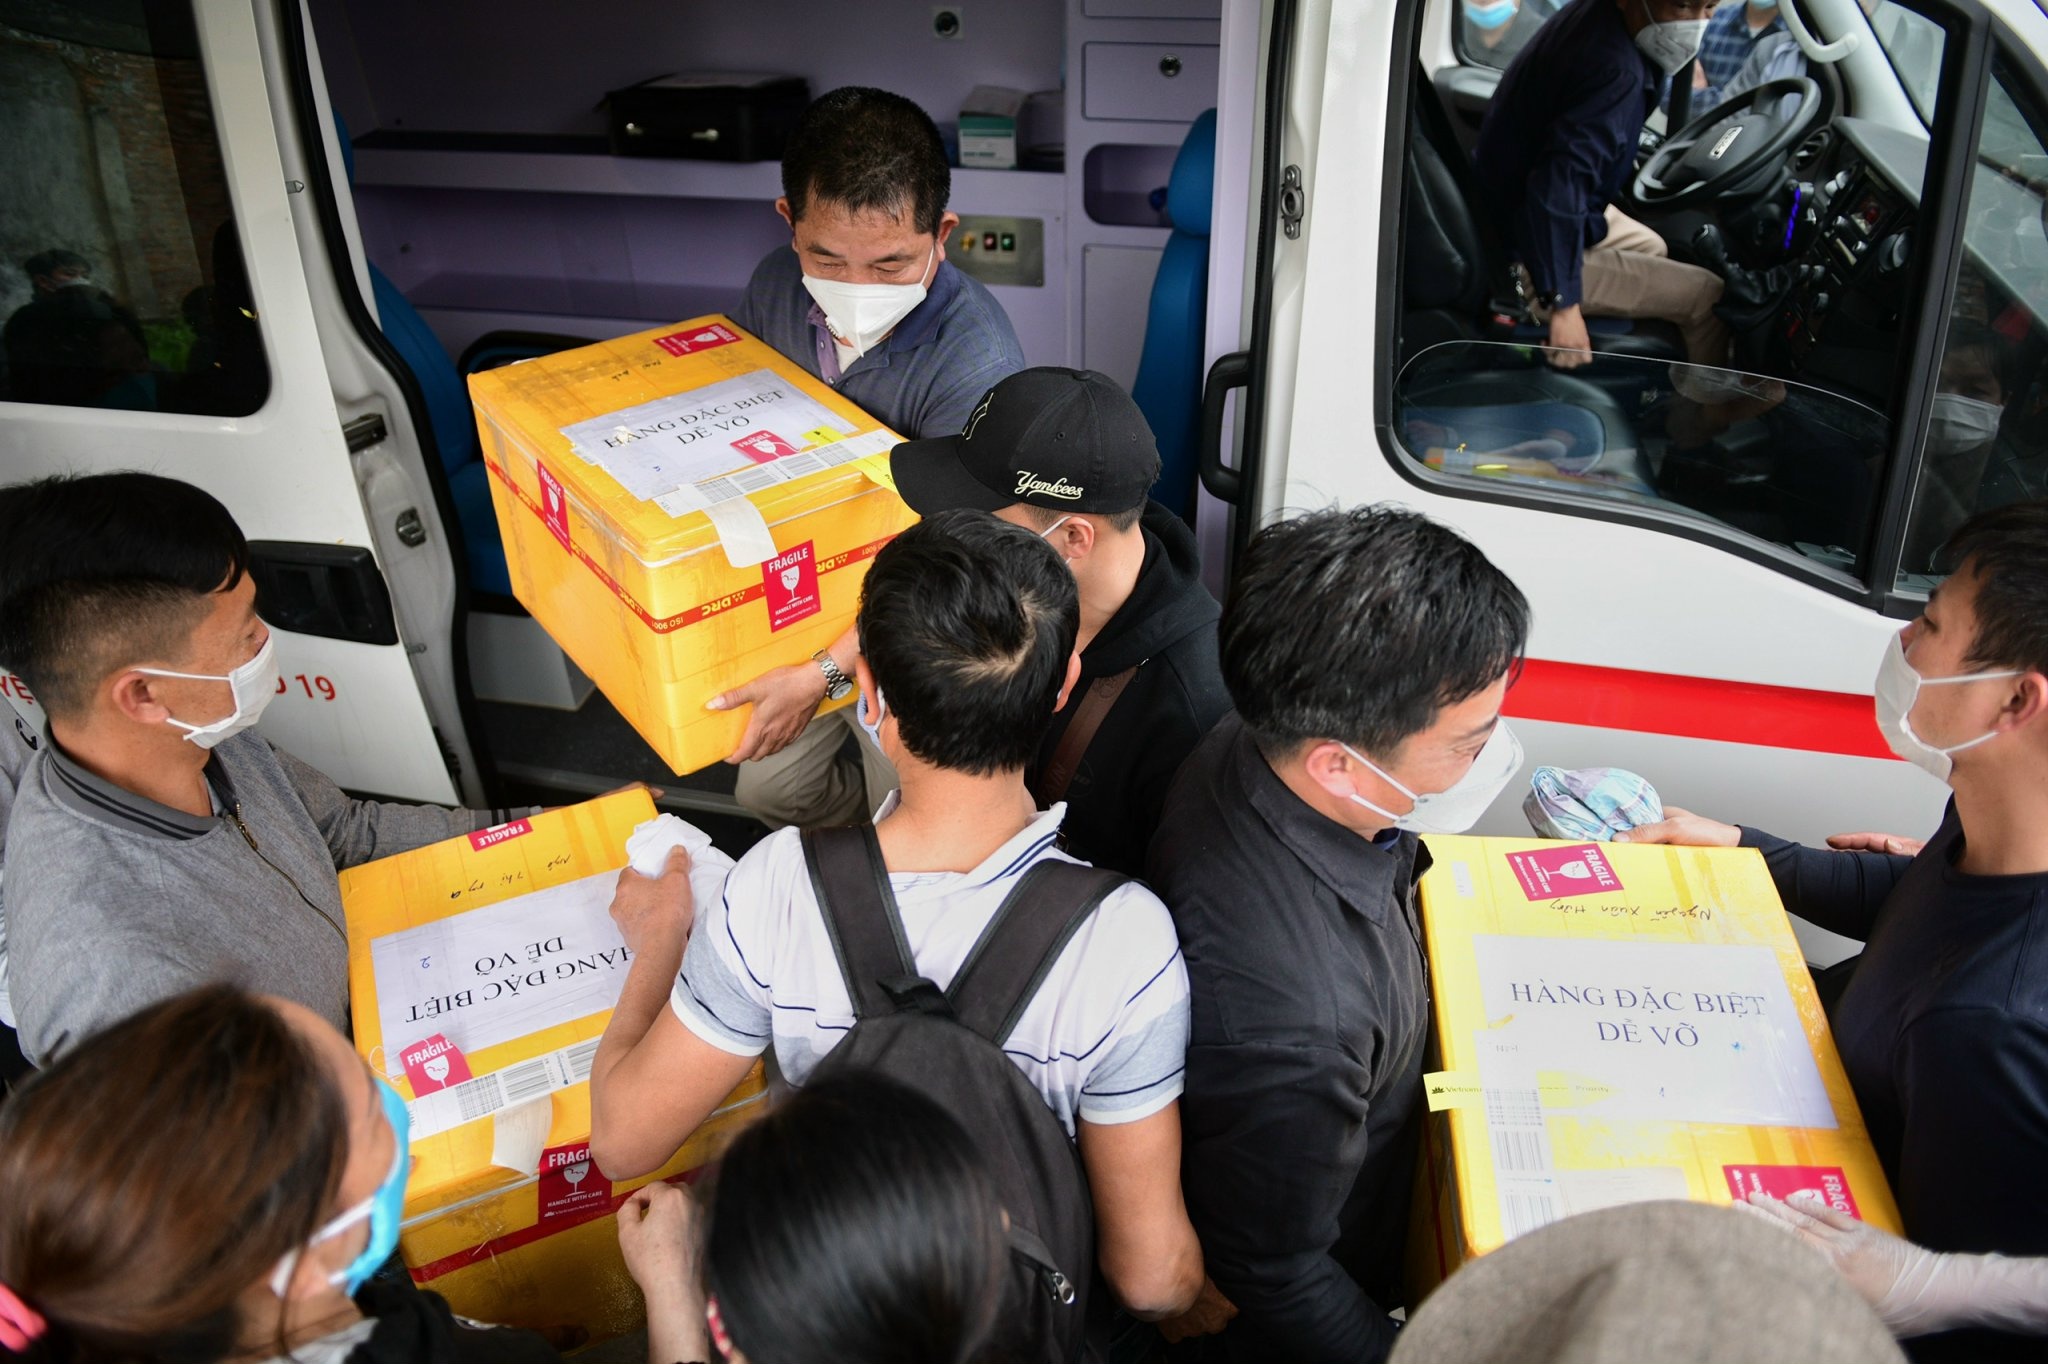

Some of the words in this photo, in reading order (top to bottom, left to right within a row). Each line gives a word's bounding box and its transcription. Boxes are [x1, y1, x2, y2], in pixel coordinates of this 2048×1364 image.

[679, 405, 732, 425] ĐẶC
[734, 389, 785, 410] BIỆT
[715, 415, 750, 432] VỠ
[1014, 470, 1084, 499] Yankees
[768, 547, 809, 574] FRAGILE
[816, 560, 835, 574] DR
[701, 596, 731, 616] DRC
[775, 604, 792, 616] HANDLE
[792, 599, 803, 609] WITH
[803, 594, 814, 604] CARE
[669, 617, 684, 628] ISO
[295, 674, 336, 702] 19
[477, 823, 525, 847] FRAGILE
[1582, 848, 1616, 887] FRAGILE
[420, 955, 431, 969] 2
[525, 936, 565, 963] DỄ
[475, 952, 518, 976] VỠ
[482, 970, 548, 1001] ĐẶC
[1511, 978, 1605, 1006] HÀNG
[1614, 985, 1686, 1014] ĐẶC
[1693, 991, 1766, 1018] BIỆT
[406, 990, 474, 1023] BIỆT
[1597, 1018, 1641, 1044] DỄ
[1649, 1022, 1699, 1047] VỠ
[407, 1039, 453, 1066] FRAGILE
[549, 1149, 592, 1167] FRAGI
[547, 1197, 571, 1207] HANDLE
[571, 1194, 588, 1203] WITH
[587, 1190, 603, 1200] CARE
